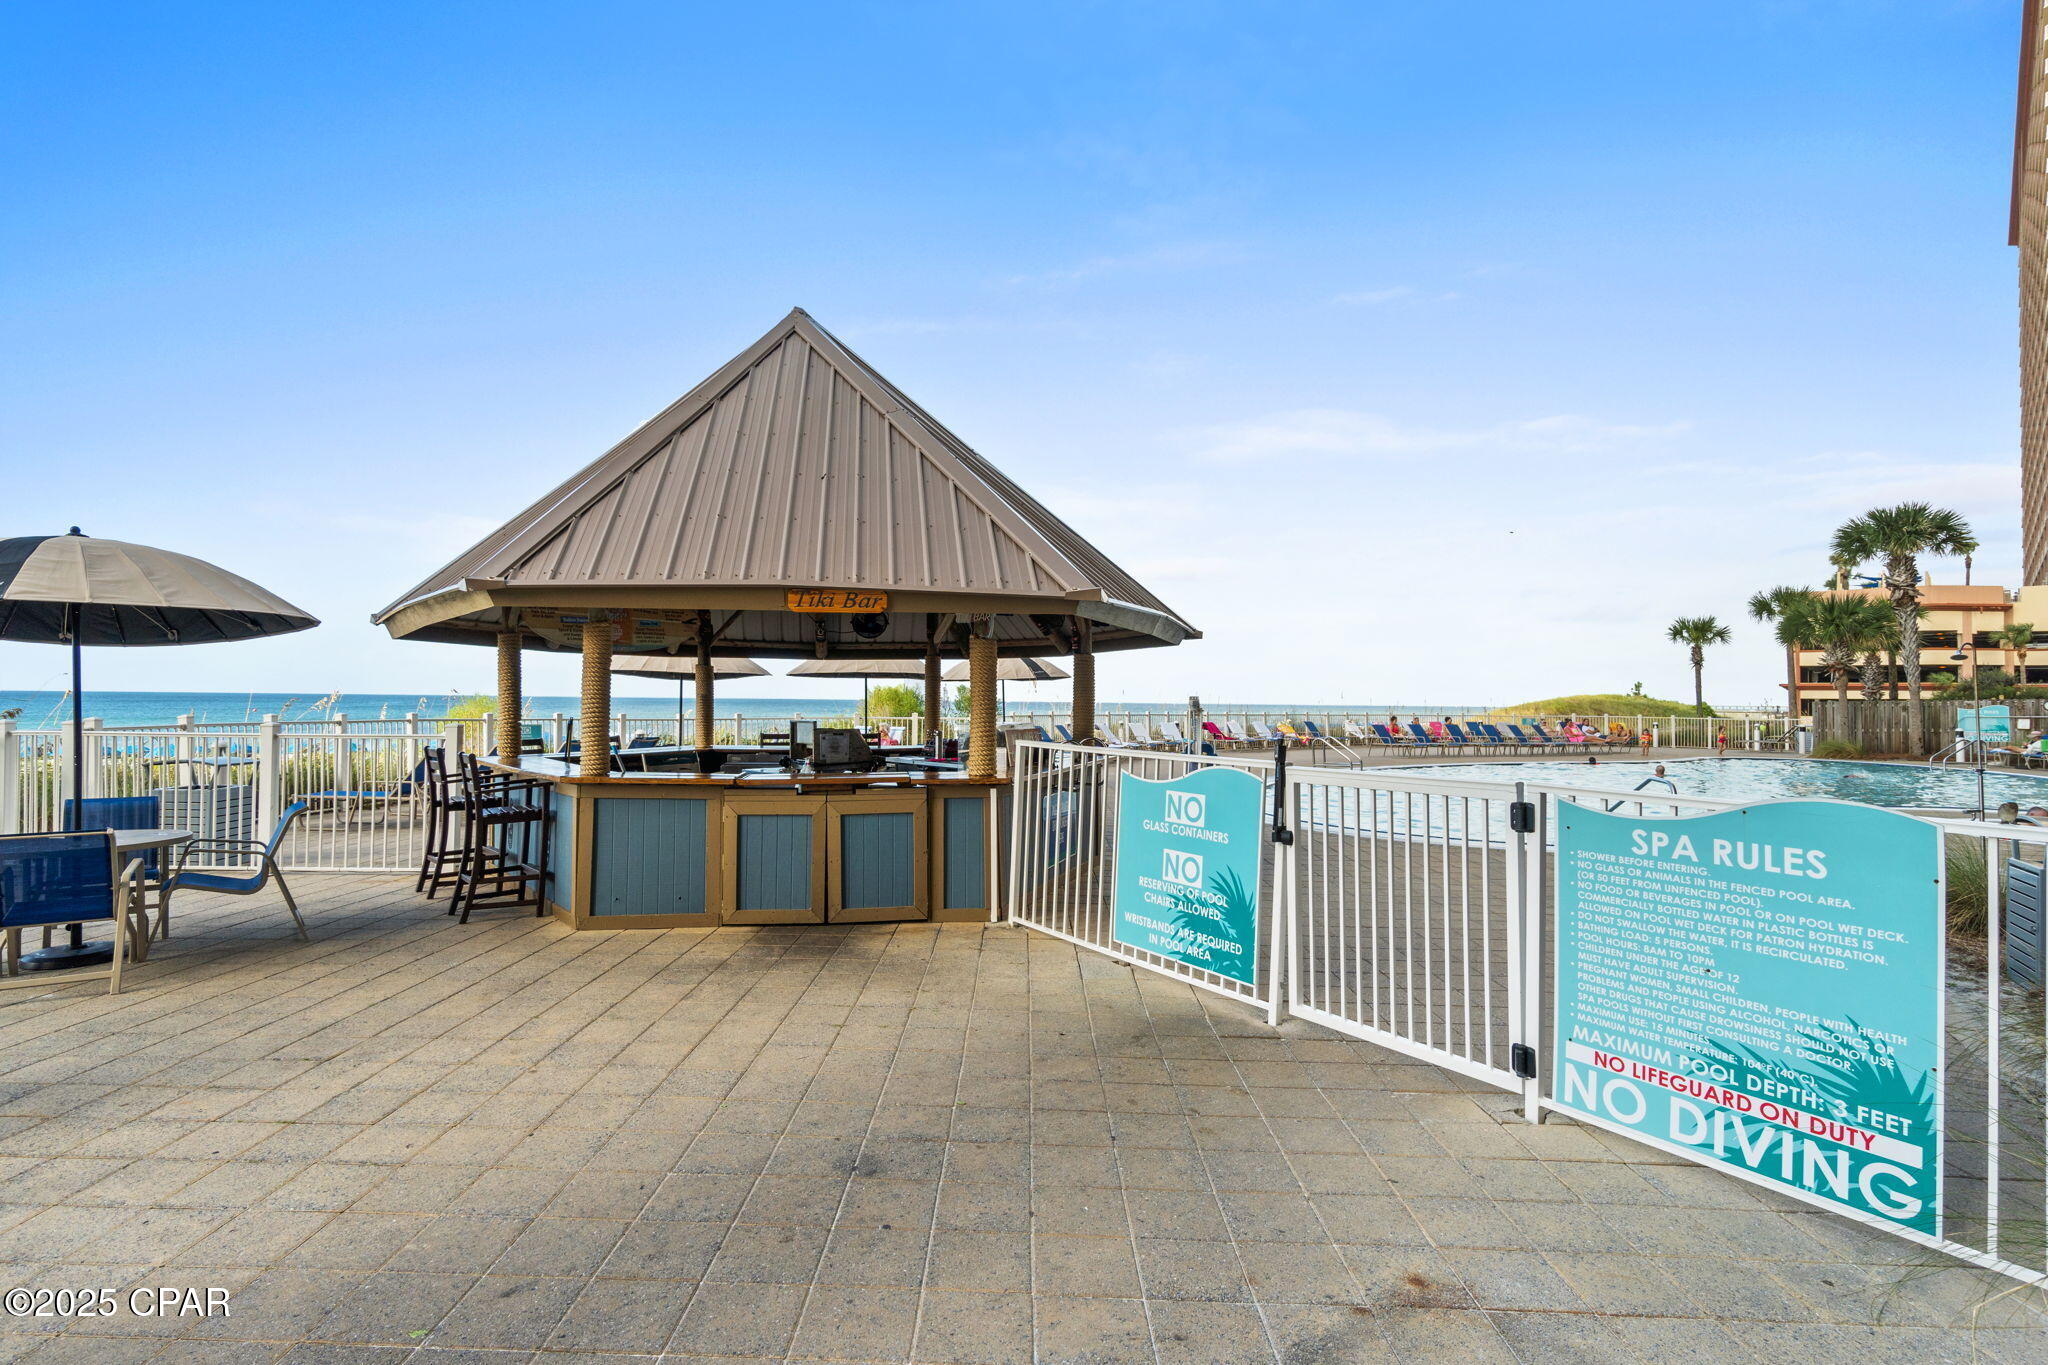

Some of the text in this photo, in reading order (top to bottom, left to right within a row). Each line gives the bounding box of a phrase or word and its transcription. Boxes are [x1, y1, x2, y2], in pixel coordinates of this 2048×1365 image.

[794, 590, 883, 609] Tiki Bar
[1168, 794, 1203, 823] NO
[1143, 819, 1229, 844] GLASS CONTAINERS
[1631, 829, 1827, 878] SPA RULES
[1165, 852, 1201, 883] NO
[1577, 850, 1711, 876] SHOWER BEFORE ENTERING.
[1577, 860, 1855, 909] NO GLASS OR ANIMALS IN THE FENCED POOL AREA.
[1139, 876, 1228, 908] RESERVING OF POOL
[1144, 892, 1221, 921] CHAIRS ALLOWED
[1577, 870, 1763, 907] (OR 50 FEET FROM UNFENCED POOL).
[1125, 911, 1243, 955] WRISTBANDS ARE REQUIRED
[1577, 890, 1874, 950] COMMERCIALLY BOTTLED WATER IN PLASTIC BOTTLES IS
[1578, 881, 1909, 943] NO FOOD OR BEVERAGES IN POOL OR ON POOL WET DECK.
[1578, 901, 1888, 966] ALLOWED ON POOL WET DECK FOR PATRON HYDRATION.
[1149, 933, 1212, 961] IN POOL AREA
[1577, 921, 1712, 955] BATHING LOAD: 5 PERSONS.
[1577, 911, 1848, 970] DO NOT SWALLOW THE WATER, IT IS RECIRCULATED.
[1577, 931, 1715, 966] POOL HOURS: 8AM TO 10PM
[1577, 941, 1739, 983] CHILDREN UNDER THE AGE OF 12
[1577, 951, 1738, 994] MUST HAVE ADULT SUPERVISION.
[1577, 961, 1907, 1046] PREGNANT WOMEN, SMALL CHILDREN, PEOPLE WITH HEALTH
[1577, 971, 1894, 1056] PROBLEMS AND PEOPLE USING ALCOHOL, NARCOTICS OR
[1577, 1002, 1712, 1046] MAXIMUM USE: 15 MINUTES.
[1577, 982, 1893, 1069] OTHER DRUGS THAT CAUSE DROWSINESS SHOULD NOT USE
[1577, 992, 1855, 1071] SPA POOLS WITHOUT FIRST CONSULTING A DOCTOR.
[1577, 1012, 1625, 1033] MAXIMUM
[1628, 1026, 1661, 1042] WATER
[1663, 1035, 1737, 1064] TEMPERATURE:
[1573, 1024, 1912, 1136] MAXIMUM POOL DEPTH: 3 FEET
[1594, 1050, 1876, 1151] NO LIFEGUARD ON DUTY
[1564, 1061, 1922, 1219] NO DIVING
